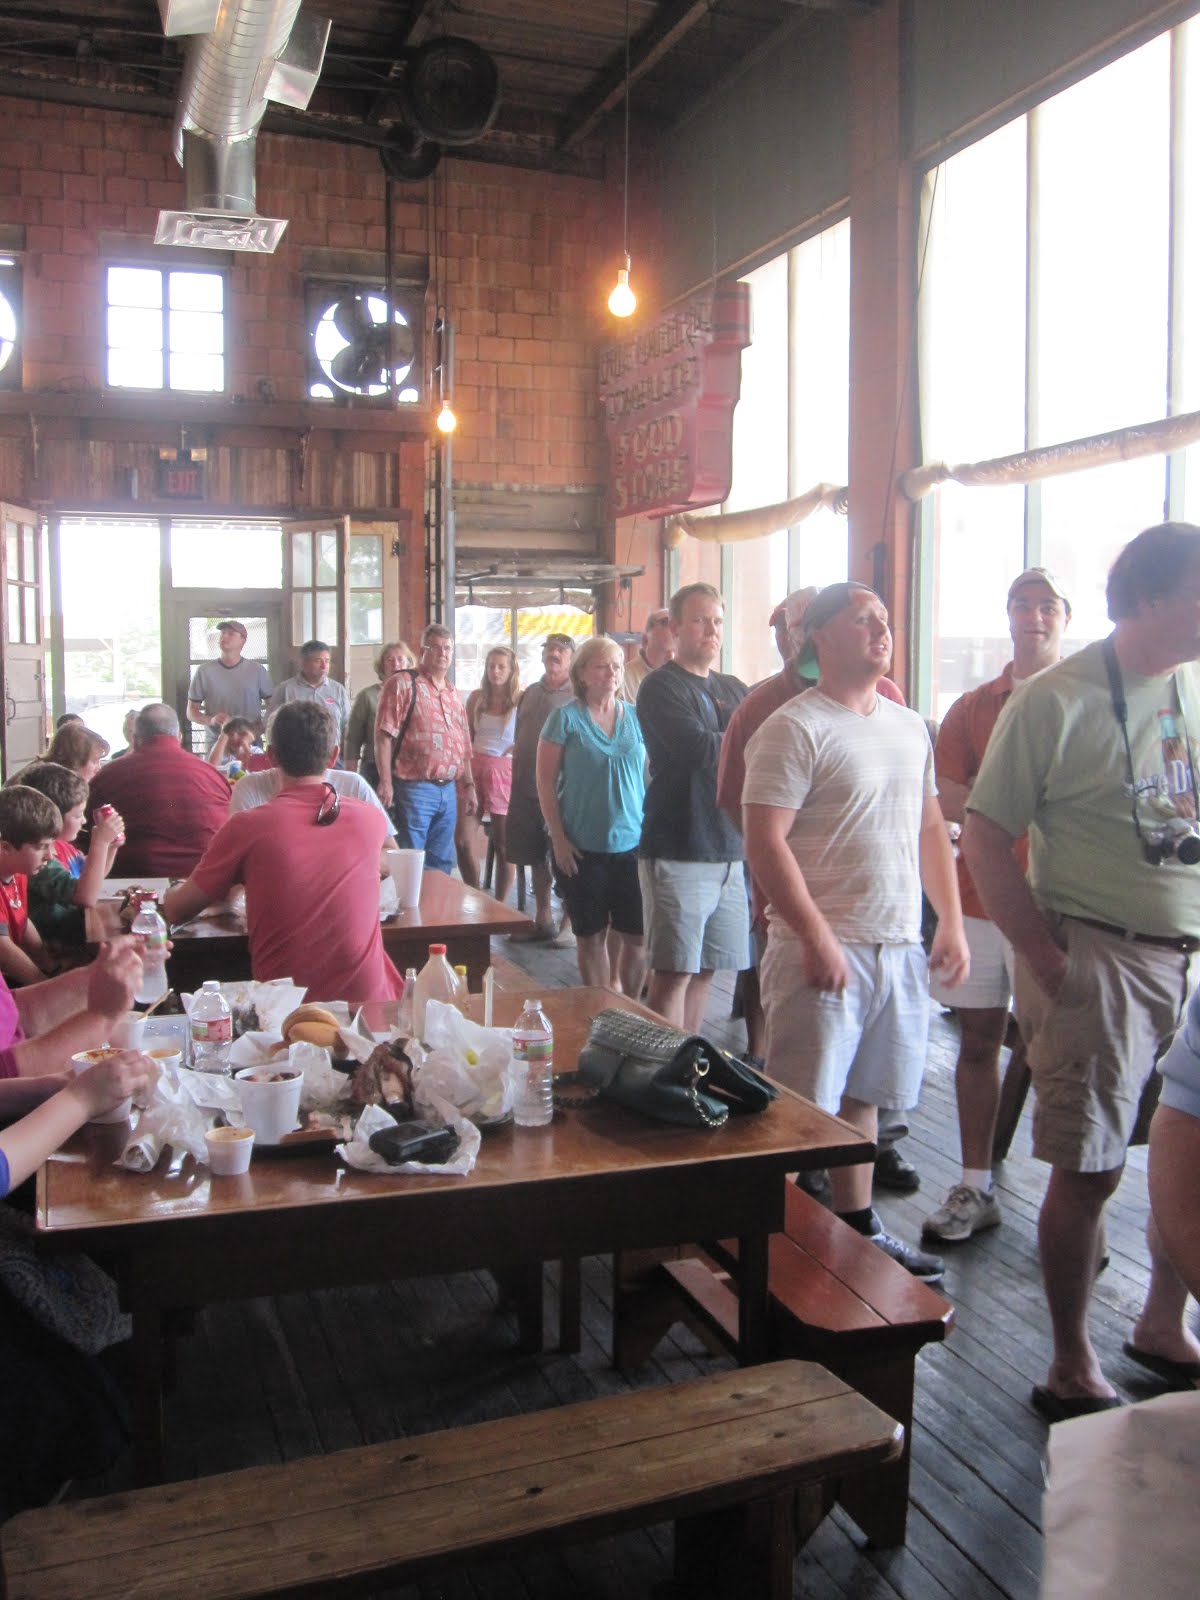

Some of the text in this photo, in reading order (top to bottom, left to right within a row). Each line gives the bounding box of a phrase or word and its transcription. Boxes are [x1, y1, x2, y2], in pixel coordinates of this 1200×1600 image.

[616, 412, 683, 466] FOOD
[168, 470, 198, 494] EXIT
[614, 455, 690, 511] STORE
